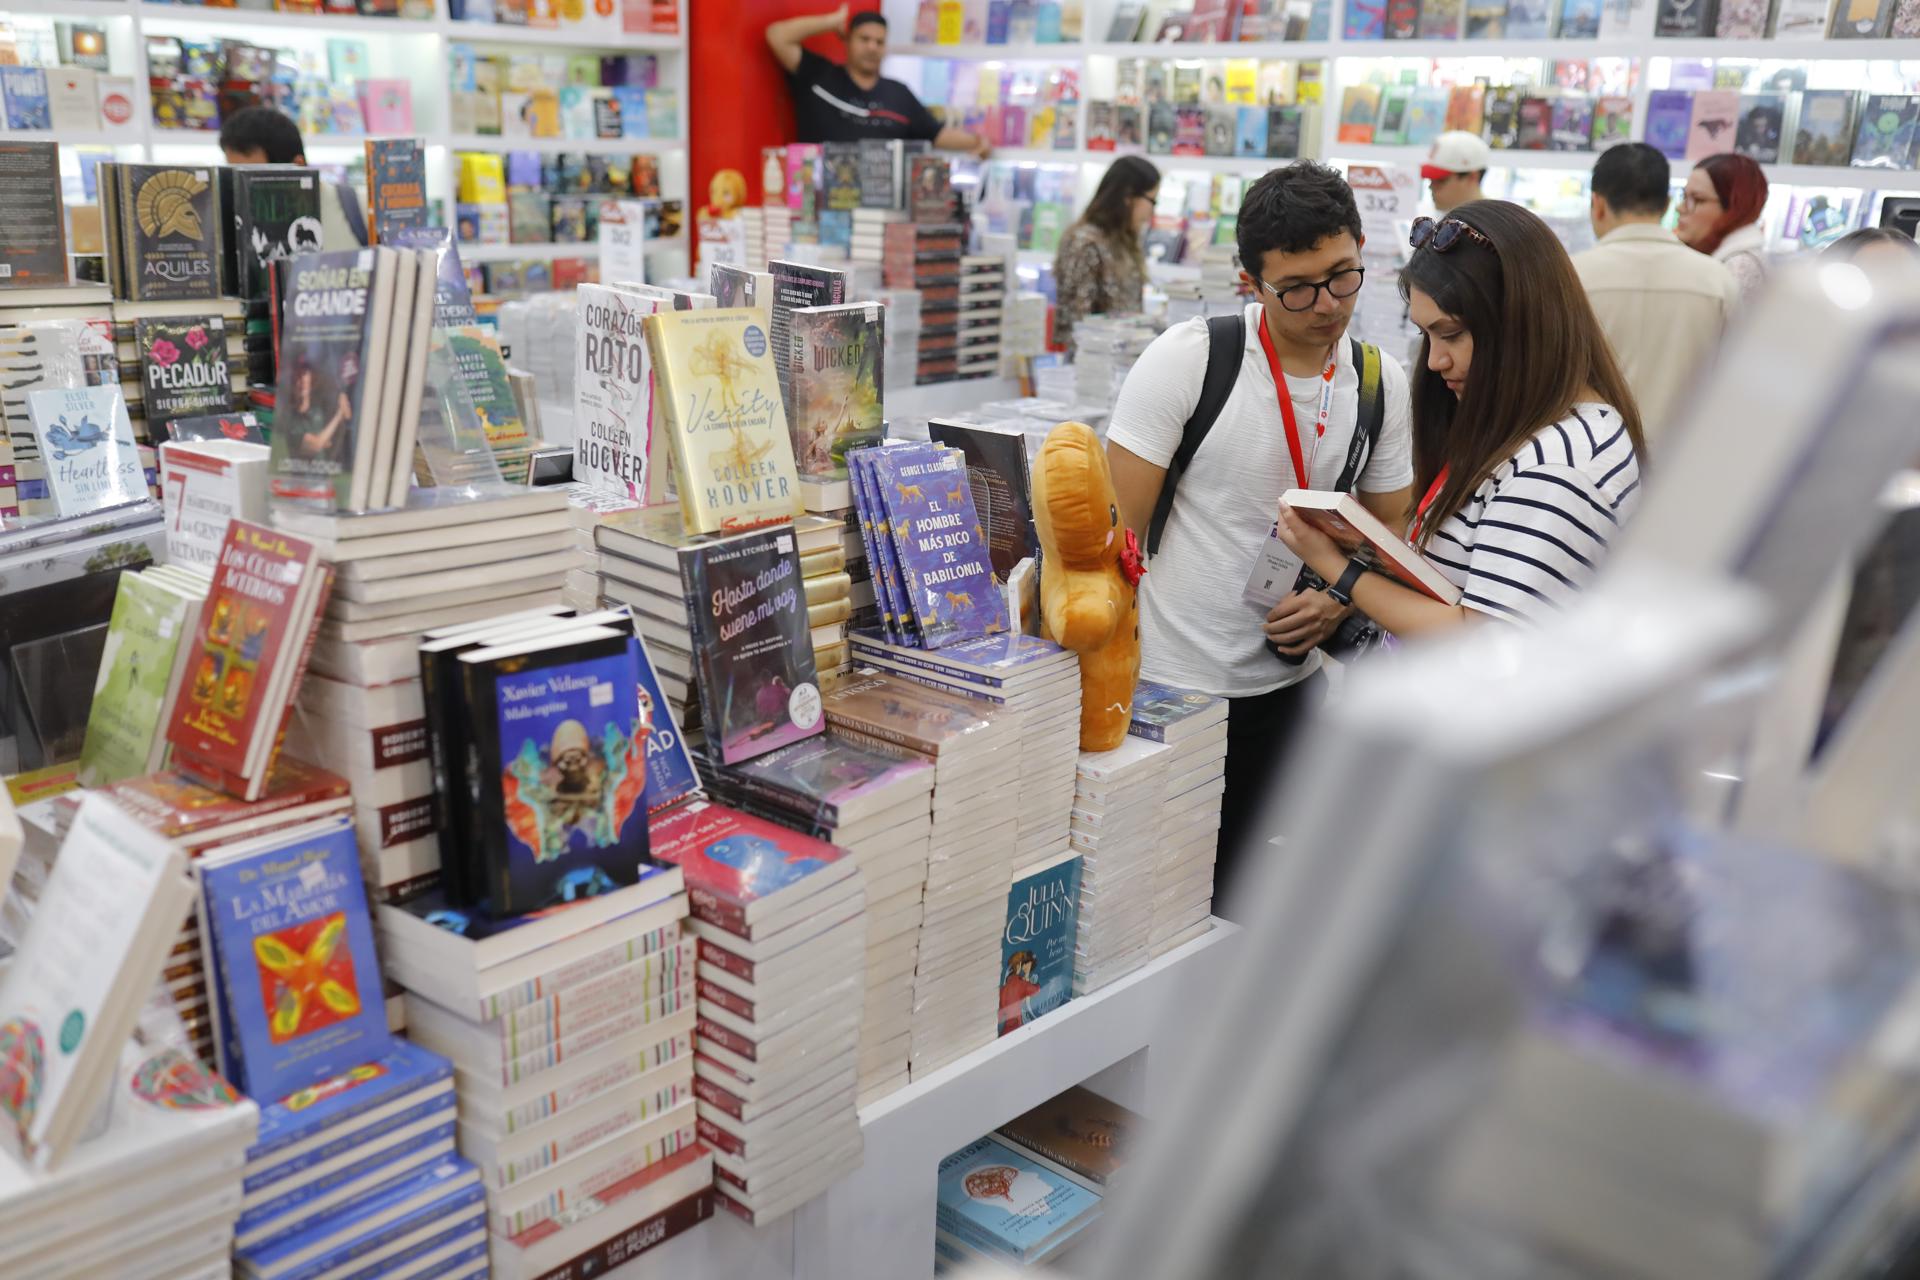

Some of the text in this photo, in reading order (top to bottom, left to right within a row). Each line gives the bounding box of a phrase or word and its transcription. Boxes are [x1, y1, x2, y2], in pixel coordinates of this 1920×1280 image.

[143, 259, 212, 282] AQUILES
[297, 262, 346, 292] SOÑAR
[294, 287, 367, 318] GRANDE
[585, 303, 644, 339] CORAZÓN
[585, 332, 642, 384] ROTO
[793, 335, 804, 374] WICKED
[813, 343, 861, 373] WICKED
[149, 361, 229, 390] PECADOR
[686, 386, 779, 434] Verity
[591, 421, 632, 448] COLLEEN
[59, 455, 136, 483] Heartlss
[579, 438, 643, 485] HOOVER
[713, 460, 777, 482] COLLEEN
[900, 465, 921, 478] GEORGE
[706, 476, 790, 509] HOOVER
[928, 501, 942, 513] EL
[916, 513, 963, 533] HOMBRE
[708, 550, 741, 564] MARIANA
[918, 534, 944, 553] MÁS
[945, 531, 971, 547] RICO
[942, 550, 957, 564] DE
[712, 579, 757, 616] Hasta
[756, 559, 793, 591] donde
[922, 561, 985, 586] BABILONIA
[720, 588, 797, 641] suene mi voz
[1018, 879, 1065, 917] JULIA
[1006, 889, 1075, 945] QUINN
